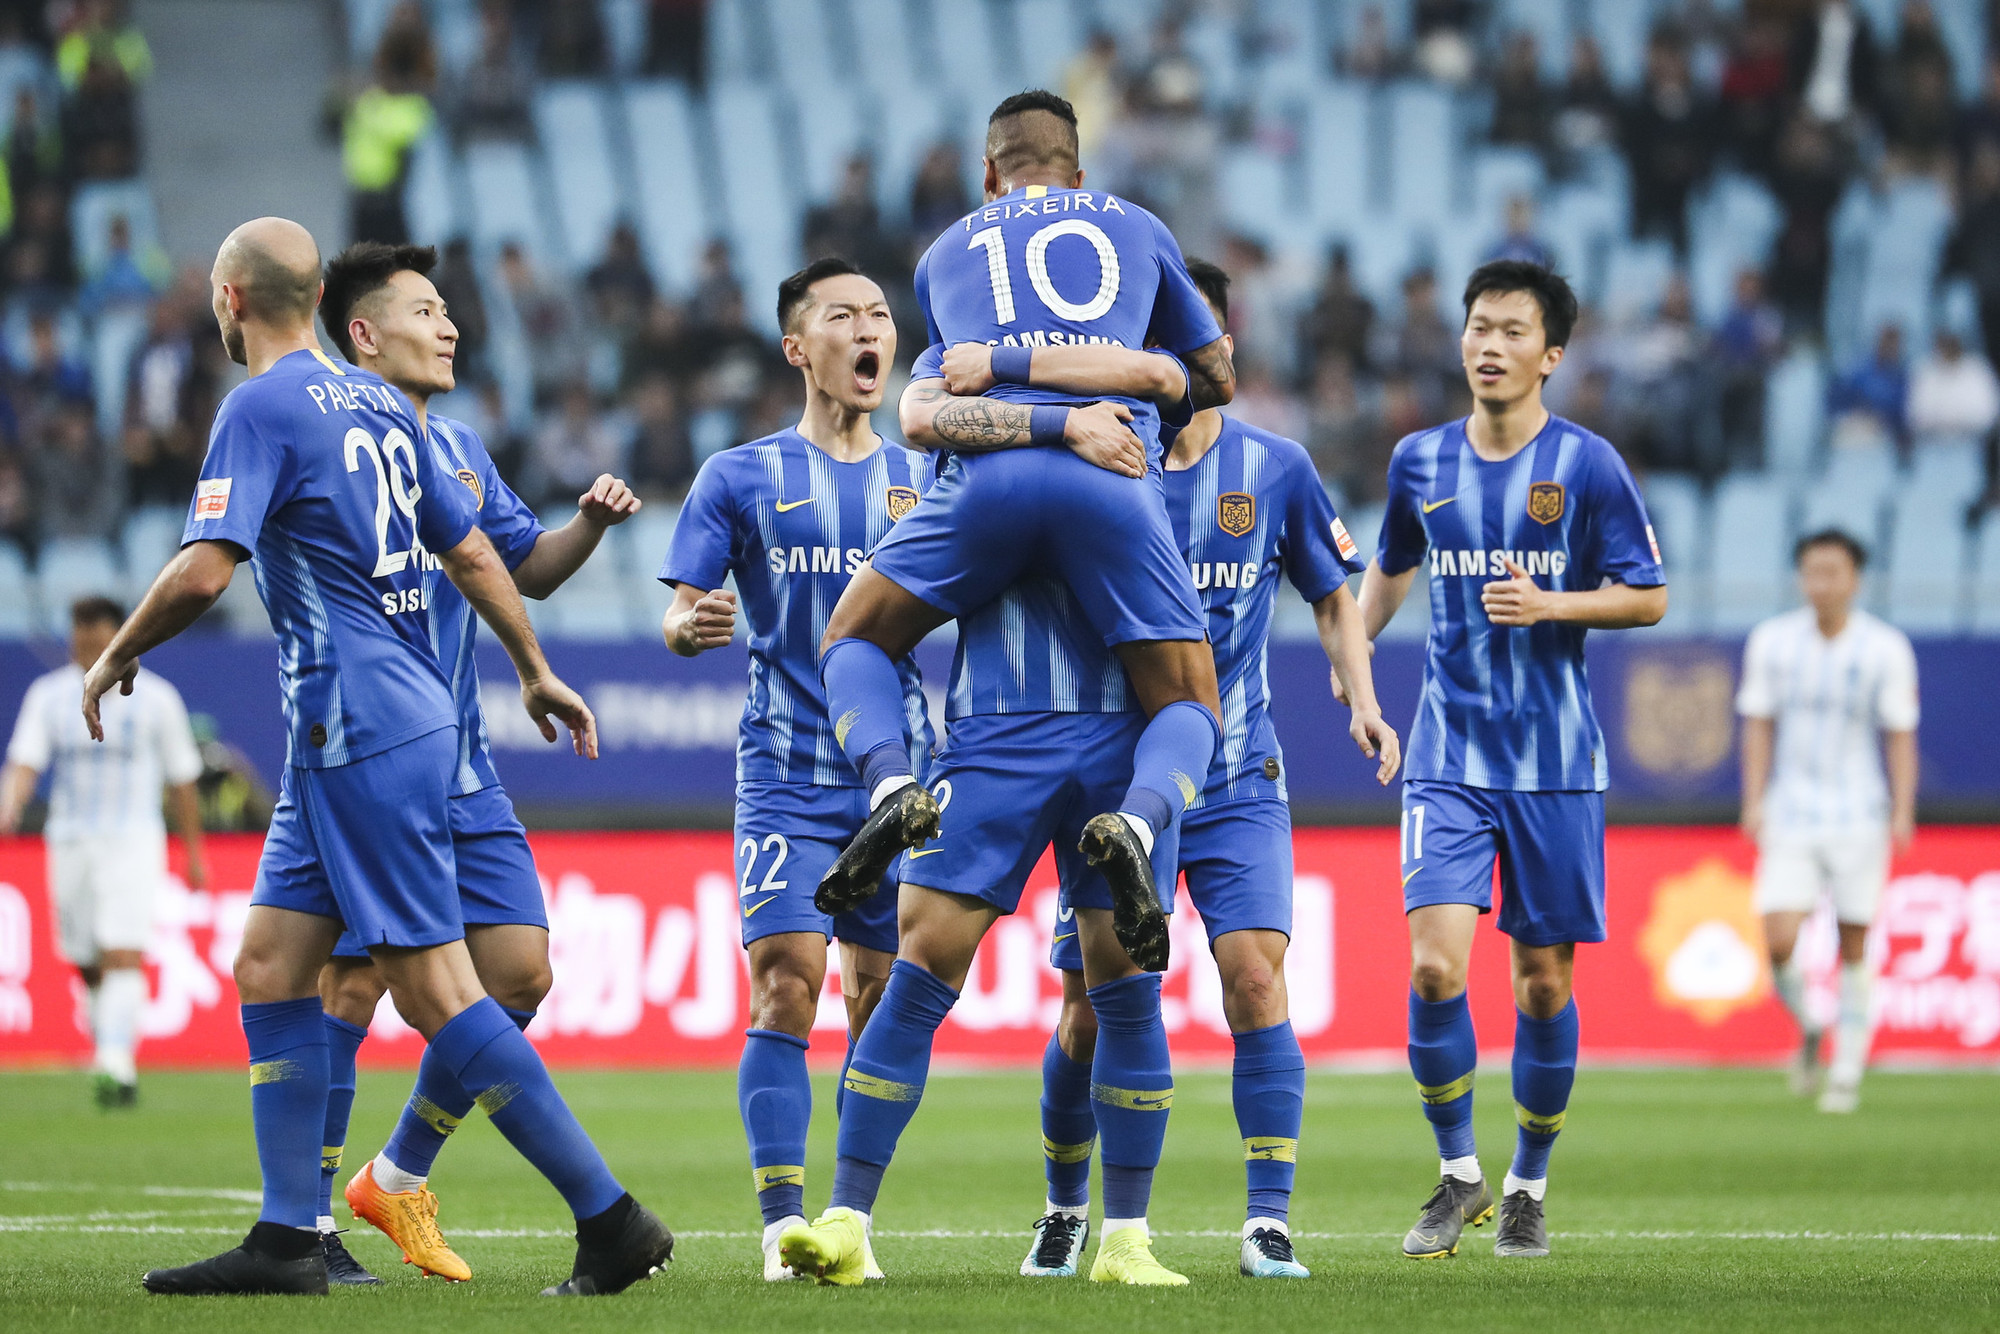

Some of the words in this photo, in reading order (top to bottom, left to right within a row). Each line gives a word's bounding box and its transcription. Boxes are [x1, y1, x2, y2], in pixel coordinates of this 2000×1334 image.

[962, 193, 1126, 232] TEIXEIRA
[967, 219, 1120, 325] 10
[986, 330, 1124, 347] AMSUN
[306, 381, 403, 414] PALETTA
[344, 427, 423, 578] 29
[769, 546, 864, 575] SAMS
[1401, 805, 1425, 865] 11
[739, 833, 788, 899] 22
